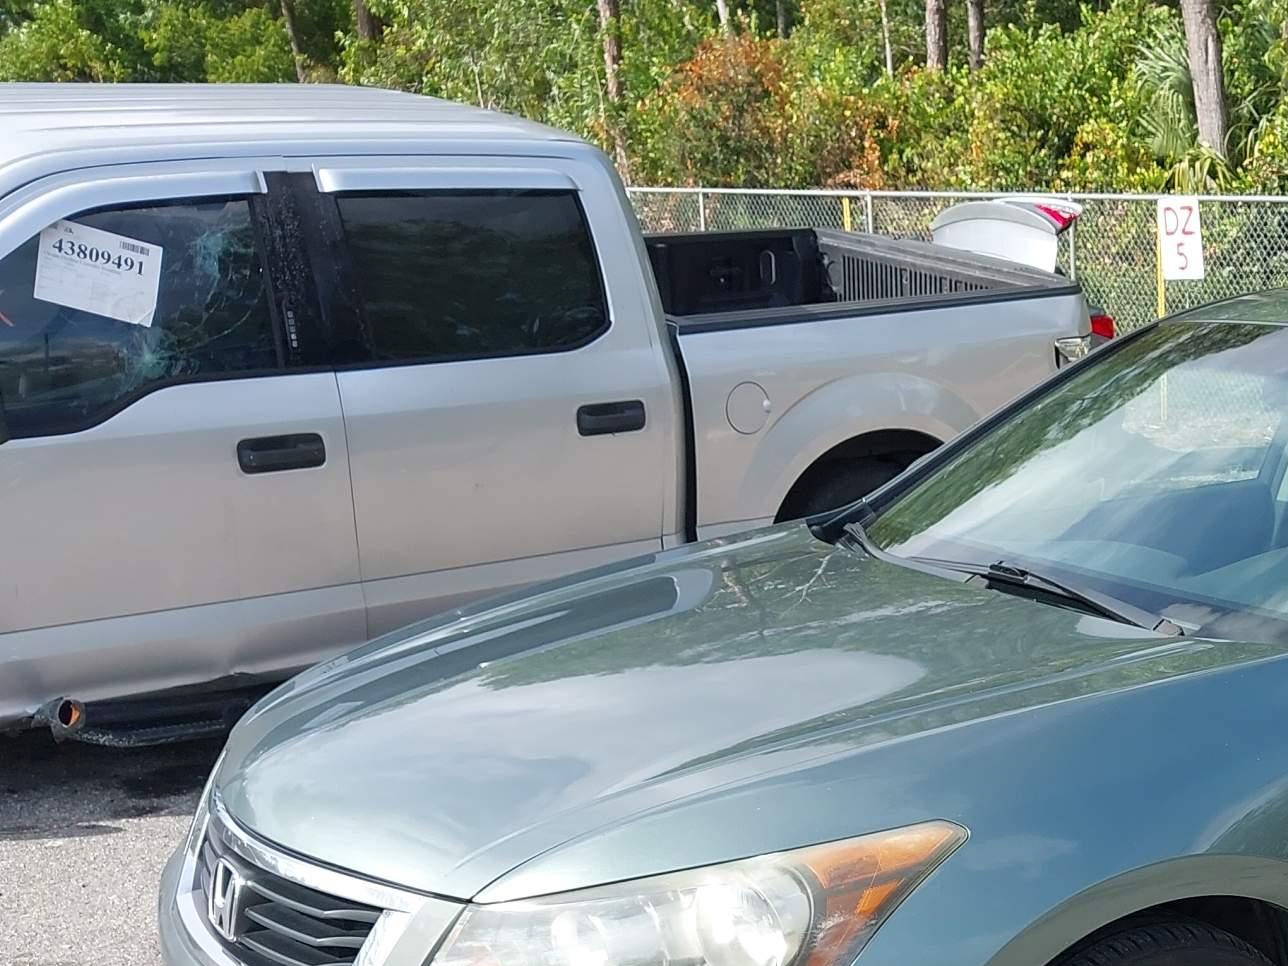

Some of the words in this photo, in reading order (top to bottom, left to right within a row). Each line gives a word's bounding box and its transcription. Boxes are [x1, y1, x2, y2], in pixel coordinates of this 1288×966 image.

[1163, 206, 1196, 236] DZ
[51, 238, 145, 276] 43809491
[1176, 242, 1189, 271] 5
